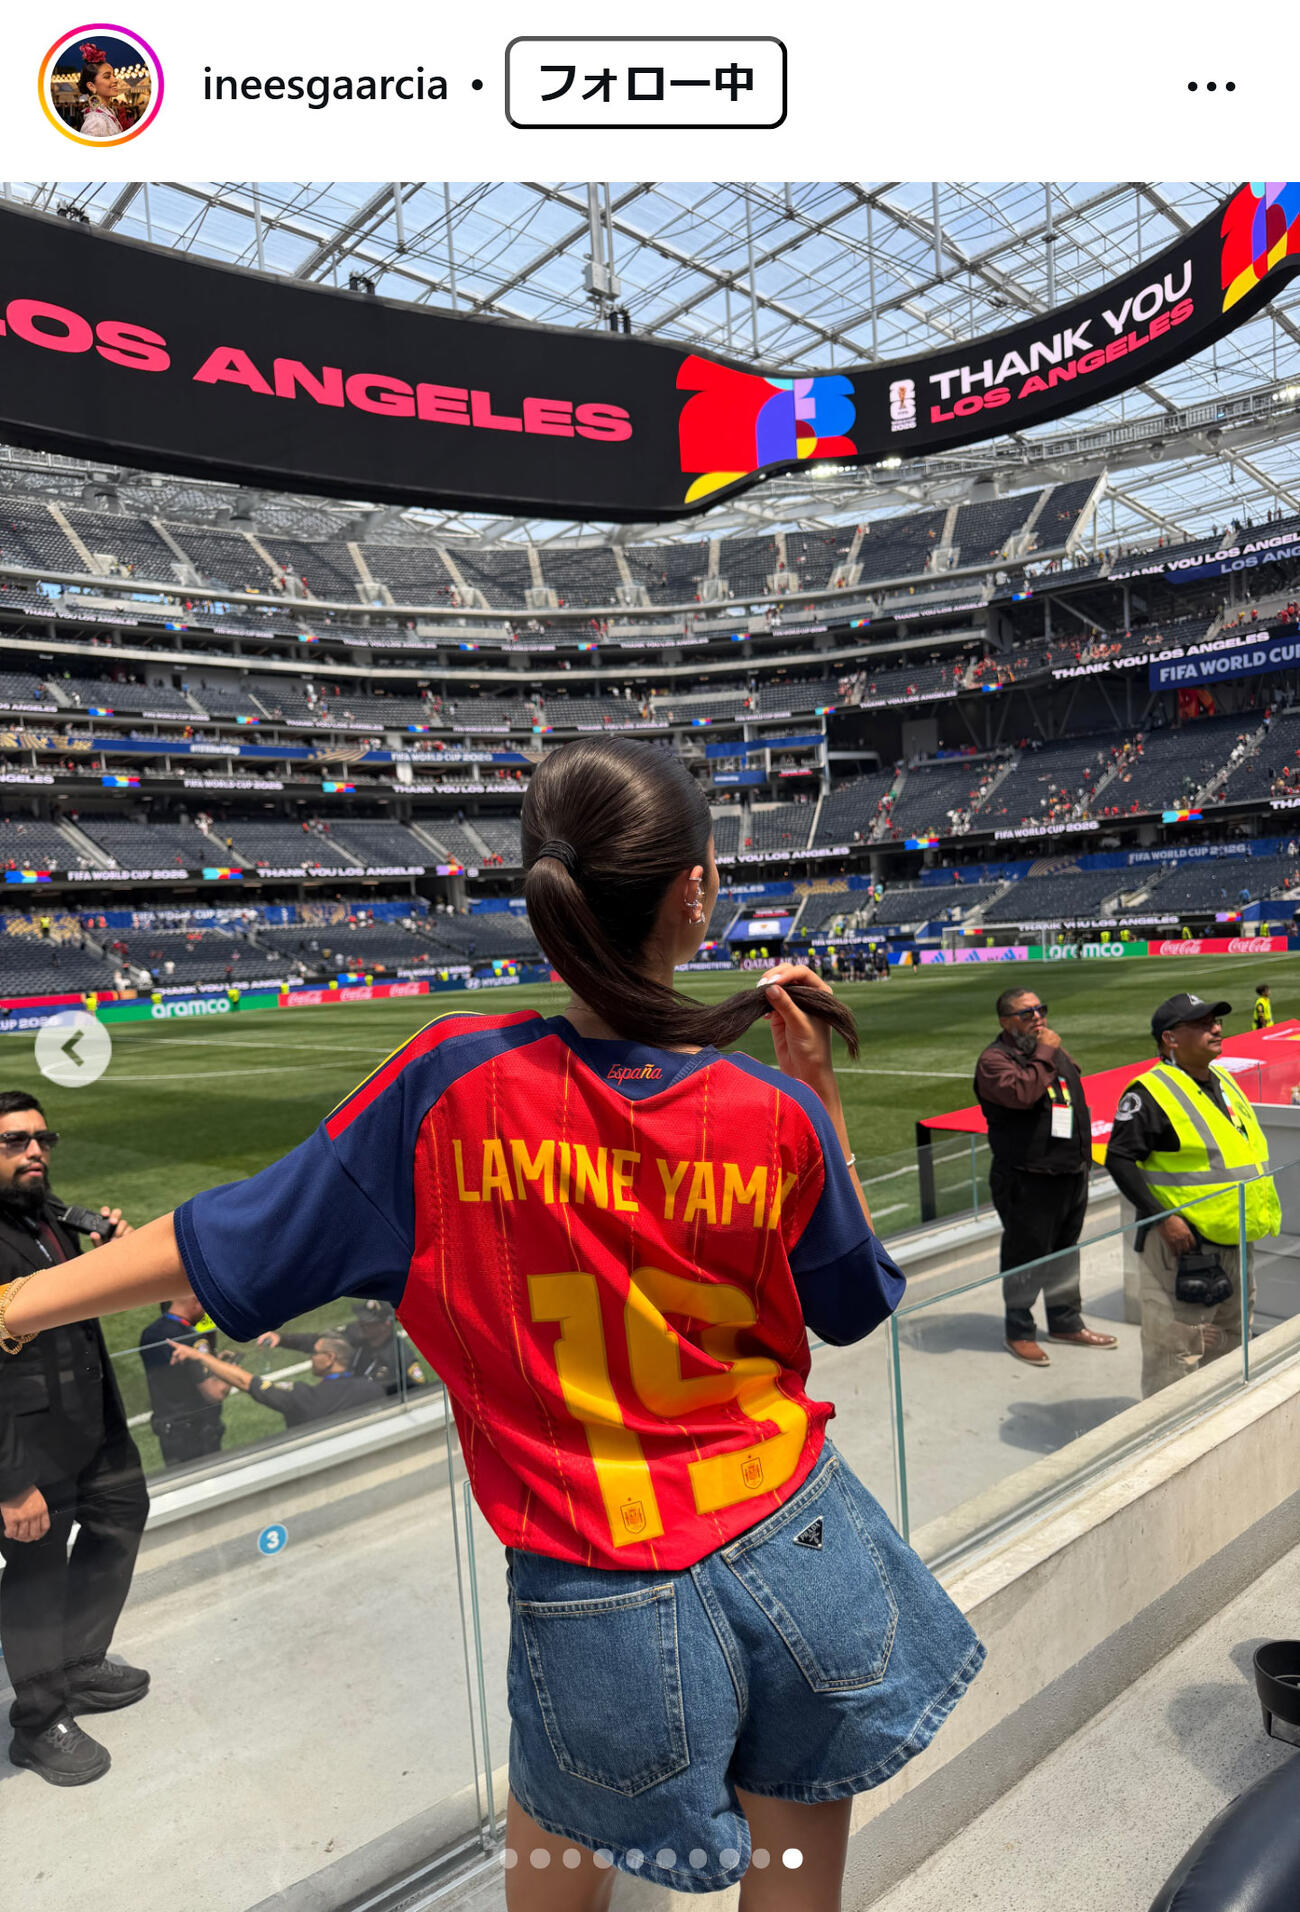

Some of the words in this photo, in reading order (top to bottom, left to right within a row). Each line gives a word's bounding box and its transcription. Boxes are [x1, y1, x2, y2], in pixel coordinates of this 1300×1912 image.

[929, 319, 1094, 400] THANK
[1101, 259, 1193, 336] YOU
[0, 298, 171, 372] OS
[193, 346, 633, 442] ANGELES
[930, 386, 1011, 424] LOS
[1018, 298, 1195, 399] ANGELES
[1167, 556, 1203, 571] YOU
[1205, 547, 1241, 563] LOS
[1221, 557, 1258, 574] LOS
[1052, 662, 1111, 680] THANK
[1112, 654, 1149, 668] YOU
[1149, 648, 1186, 663] LOS
[1186, 632, 1270, 656] ANGELES
[1159, 664, 1198, 683] FIFA
[1200, 651, 1267, 677] WORLD
[1014, 826, 1046, 838] WORLD
[1047, 823, 1065, 835] CUP
[151, 998, 230, 1018] aramco
[606, 1063, 663, 1087] España
[452, 1139, 641, 1213] LAMINE
[527, 1267, 808, 1548] 19
[266, 1530, 280, 1549] 3
